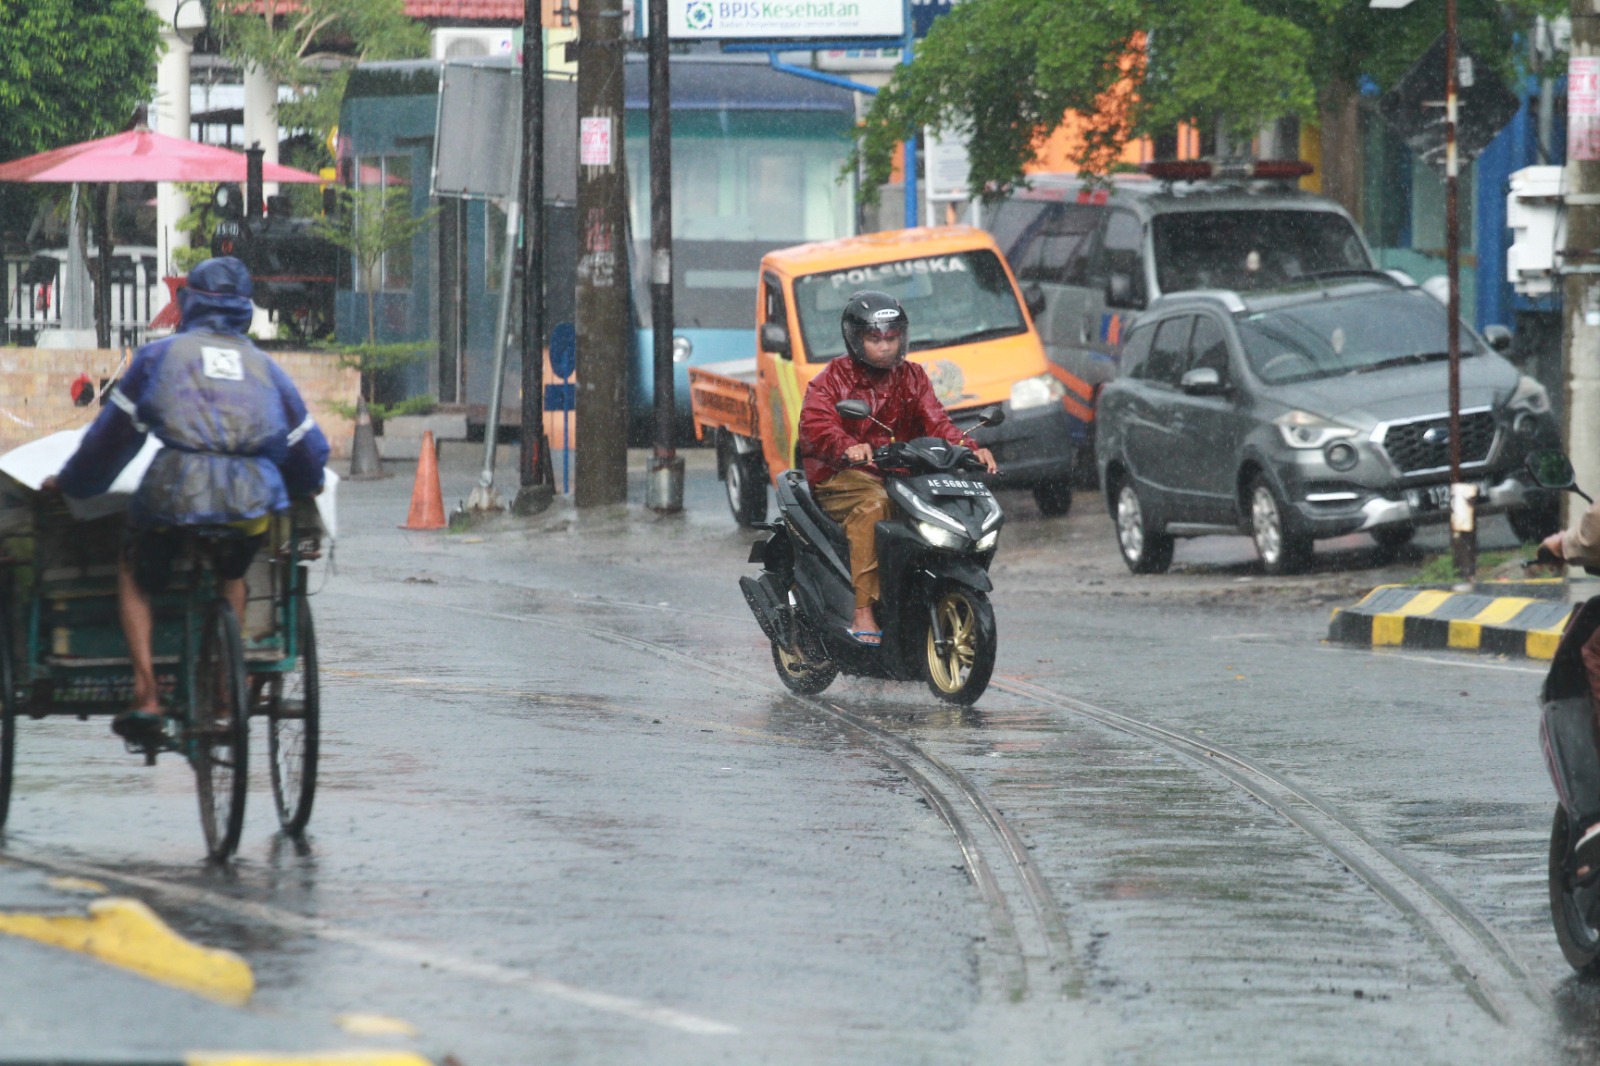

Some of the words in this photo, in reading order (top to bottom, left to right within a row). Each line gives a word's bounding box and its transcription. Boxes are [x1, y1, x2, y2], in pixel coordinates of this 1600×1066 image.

[719, 1, 760, 19] BPJS
[762, 0, 859, 18] Kesehatan
[927, 479, 941, 488] AE
